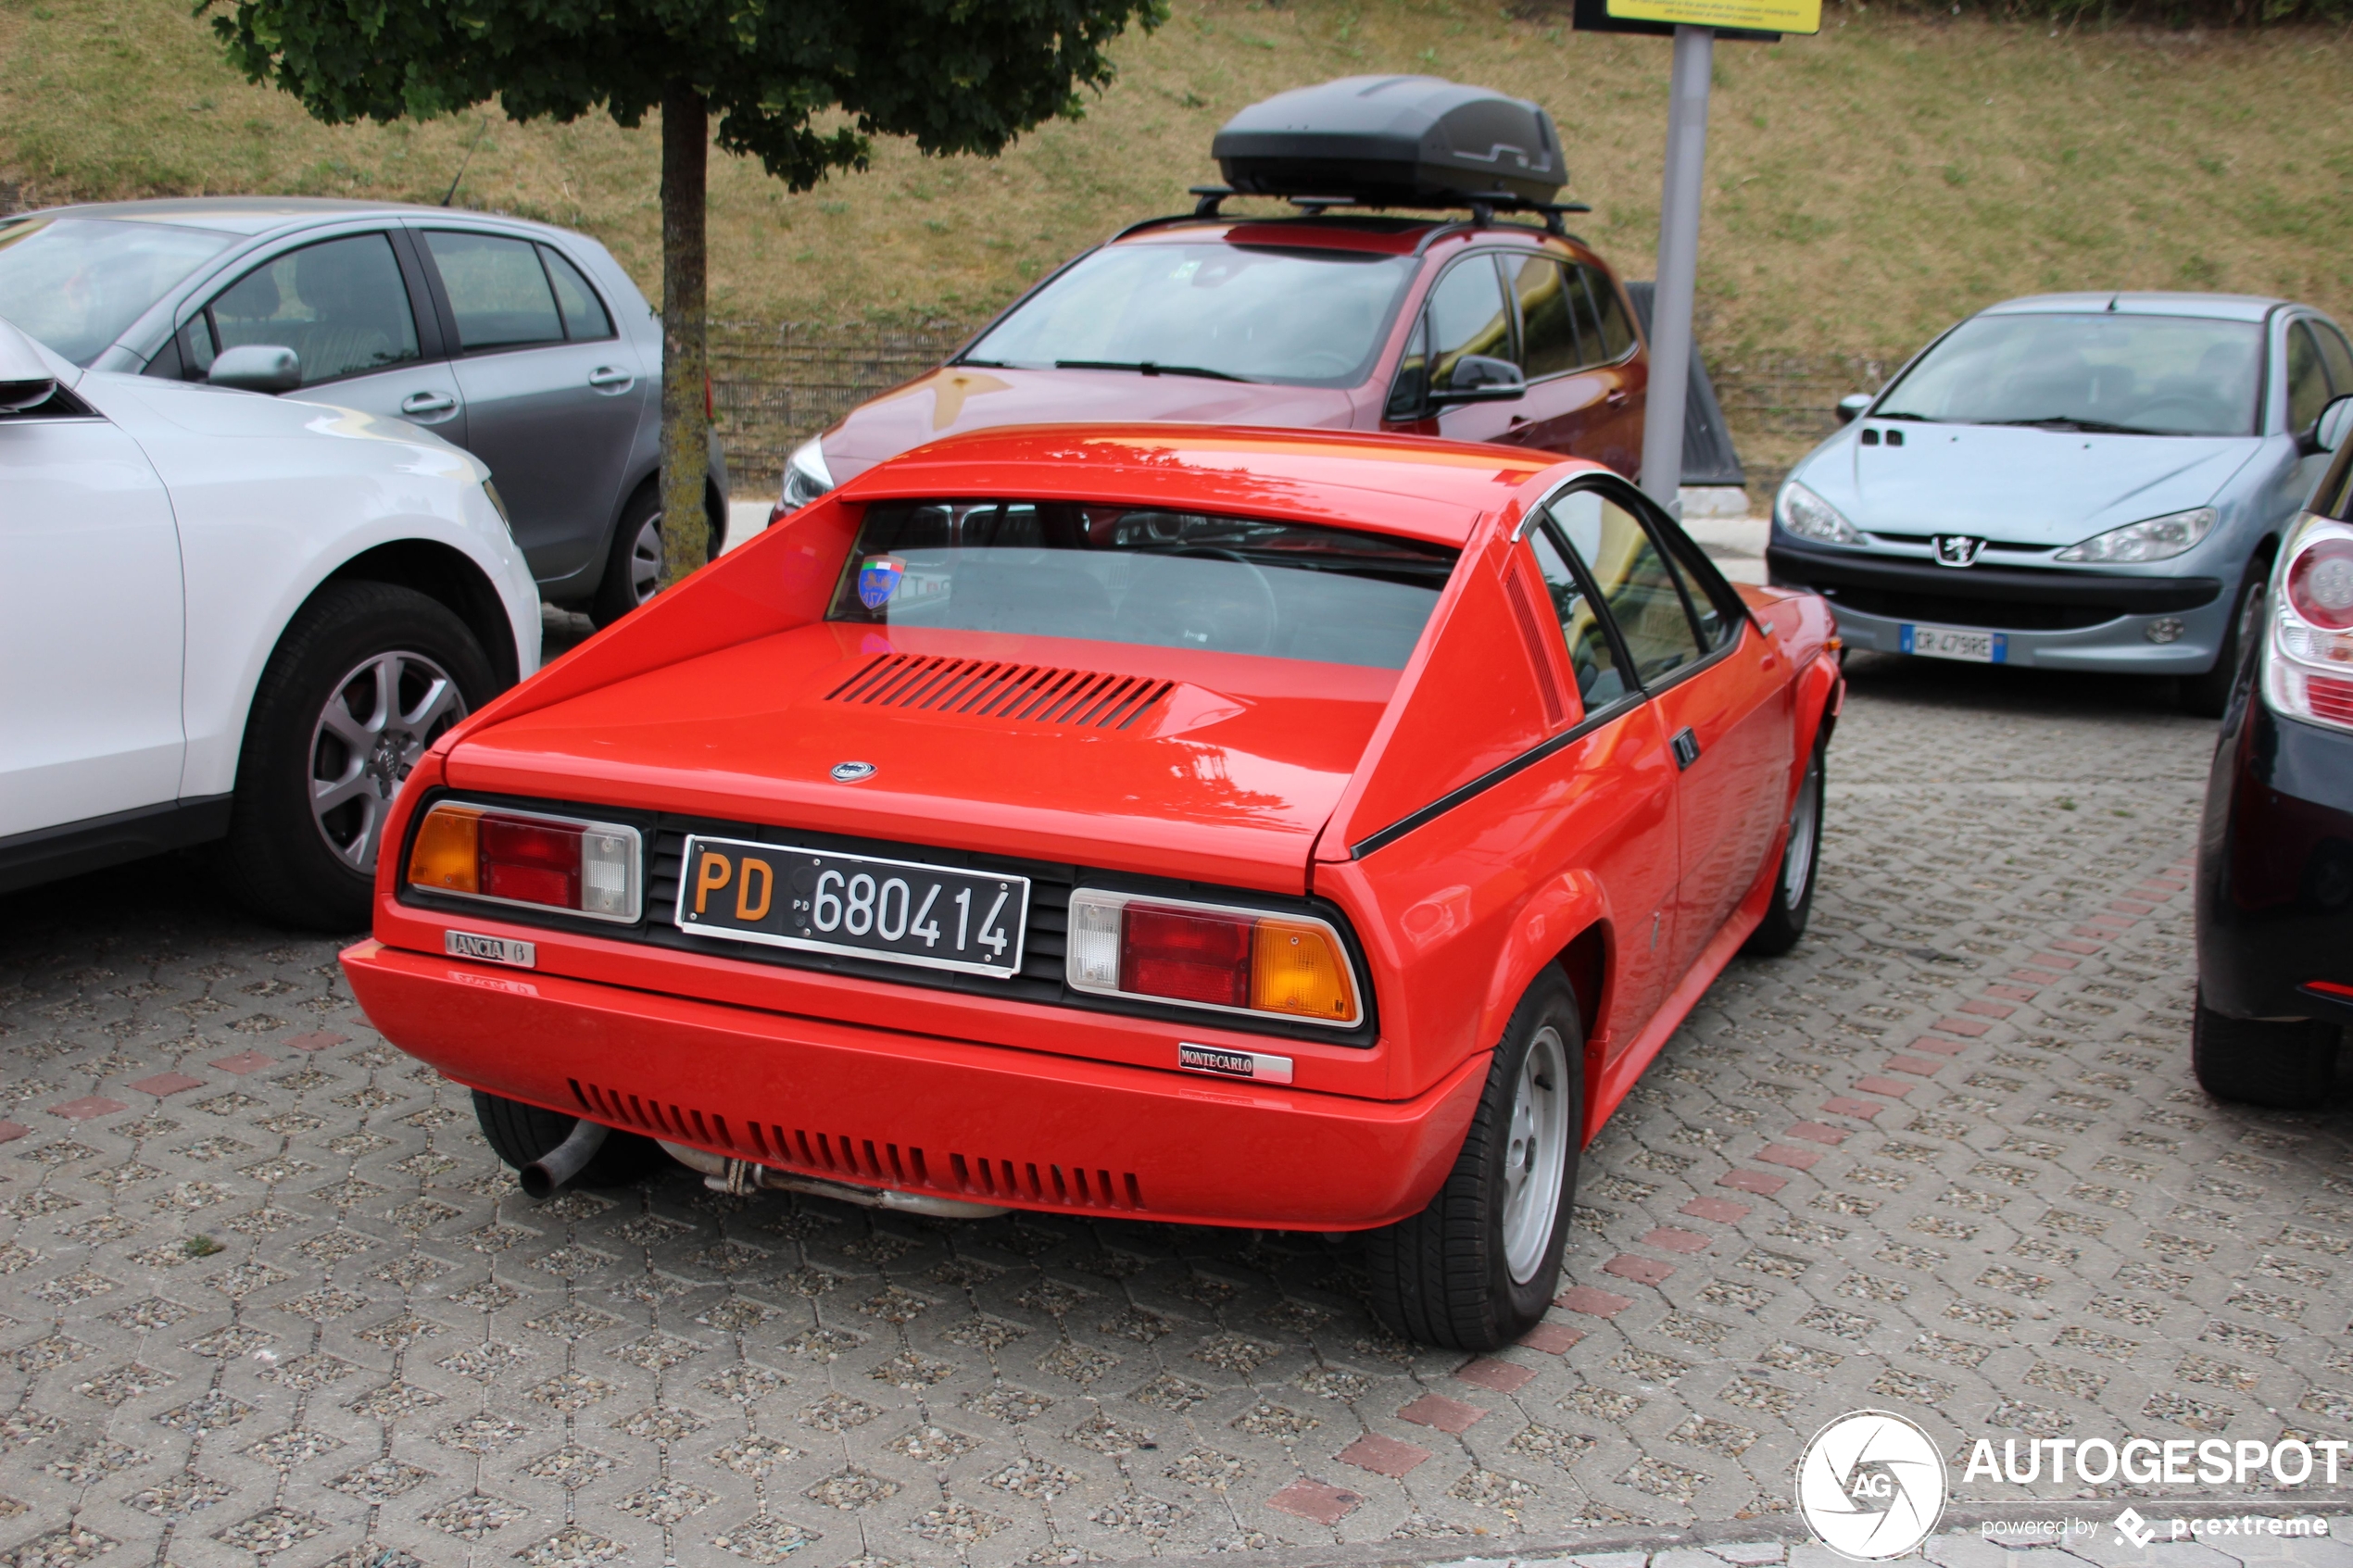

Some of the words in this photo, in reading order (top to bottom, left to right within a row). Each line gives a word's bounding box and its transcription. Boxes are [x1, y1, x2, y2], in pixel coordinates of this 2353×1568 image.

[696, 852, 774, 922] PD
[793, 899, 811, 911] PD
[813, 870, 1009, 956] 680414
